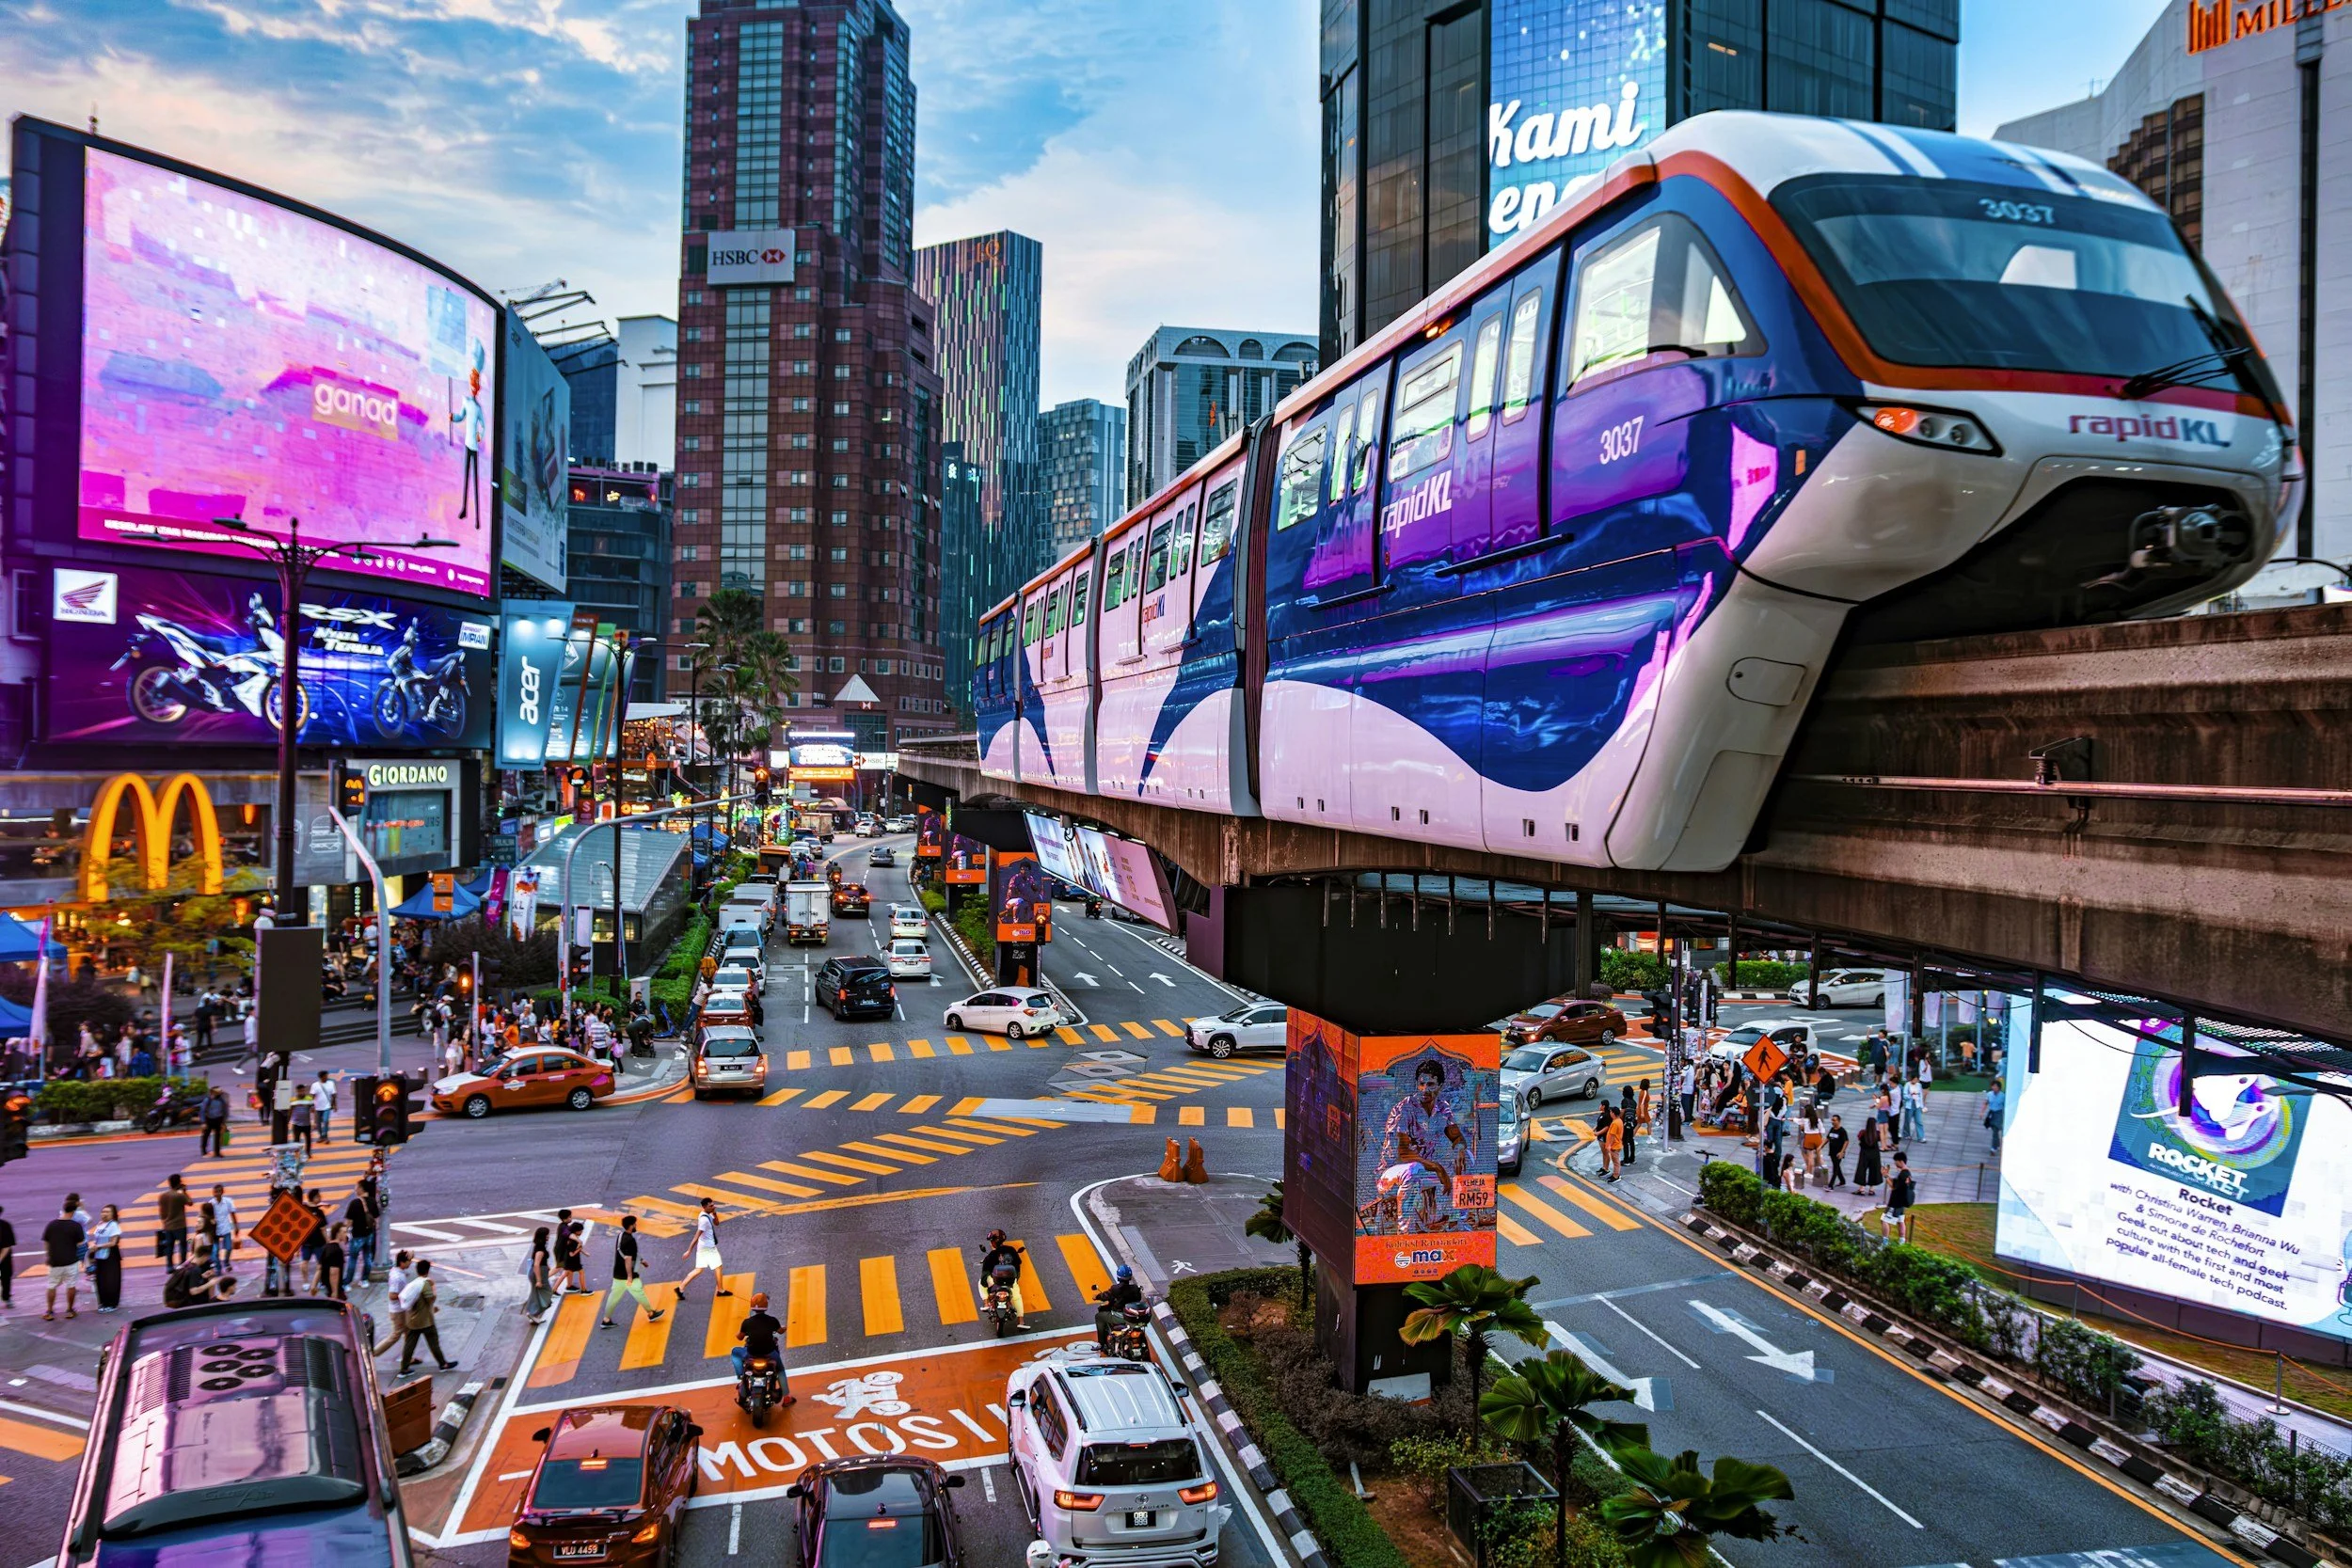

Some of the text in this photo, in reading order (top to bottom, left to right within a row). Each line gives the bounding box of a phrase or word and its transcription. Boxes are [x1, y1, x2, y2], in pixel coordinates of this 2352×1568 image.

[2235, 0, 2352, 40] MILL
[1489, 82, 1648, 167] Kami
[1979, 198, 2055, 224] 3037
[712, 249, 758, 265] HSBC
[1600, 416, 1644, 465] 3037
[2069, 414, 2231, 447] rapidKL
[1379, 469, 1452, 538] rapidKL
[298, 603, 397, 630] RSX
[460, 634, 486, 645] IMPIAN
[519, 656, 540, 725] acer
[369, 764, 448, 786] GIORDANO
[2148, 1142, 2248, 1185] ROCKET
[1459, 1192, 1488, 1206] RM59
[2179, 1188, 2233, 1215] Rocket
[2110, 1182, 2300, 1255] with Christina Warren, Brianna Wu
[2136, 1203, 2265, 1258] & Simone de Rochefort
[1412, 1249, 1456, 1263] max
[1422, 1239, 1467, 1247] Ramadan
[2117, 1227, 2284, 1294] culture with the first and most
[2118, 1212, 2290, 1282] Geek out about tech and geek
[2106, 1237, 2288, 1310] popular all-female tech podcast.
[562, 1544, 598, 1555] VLU 4459
